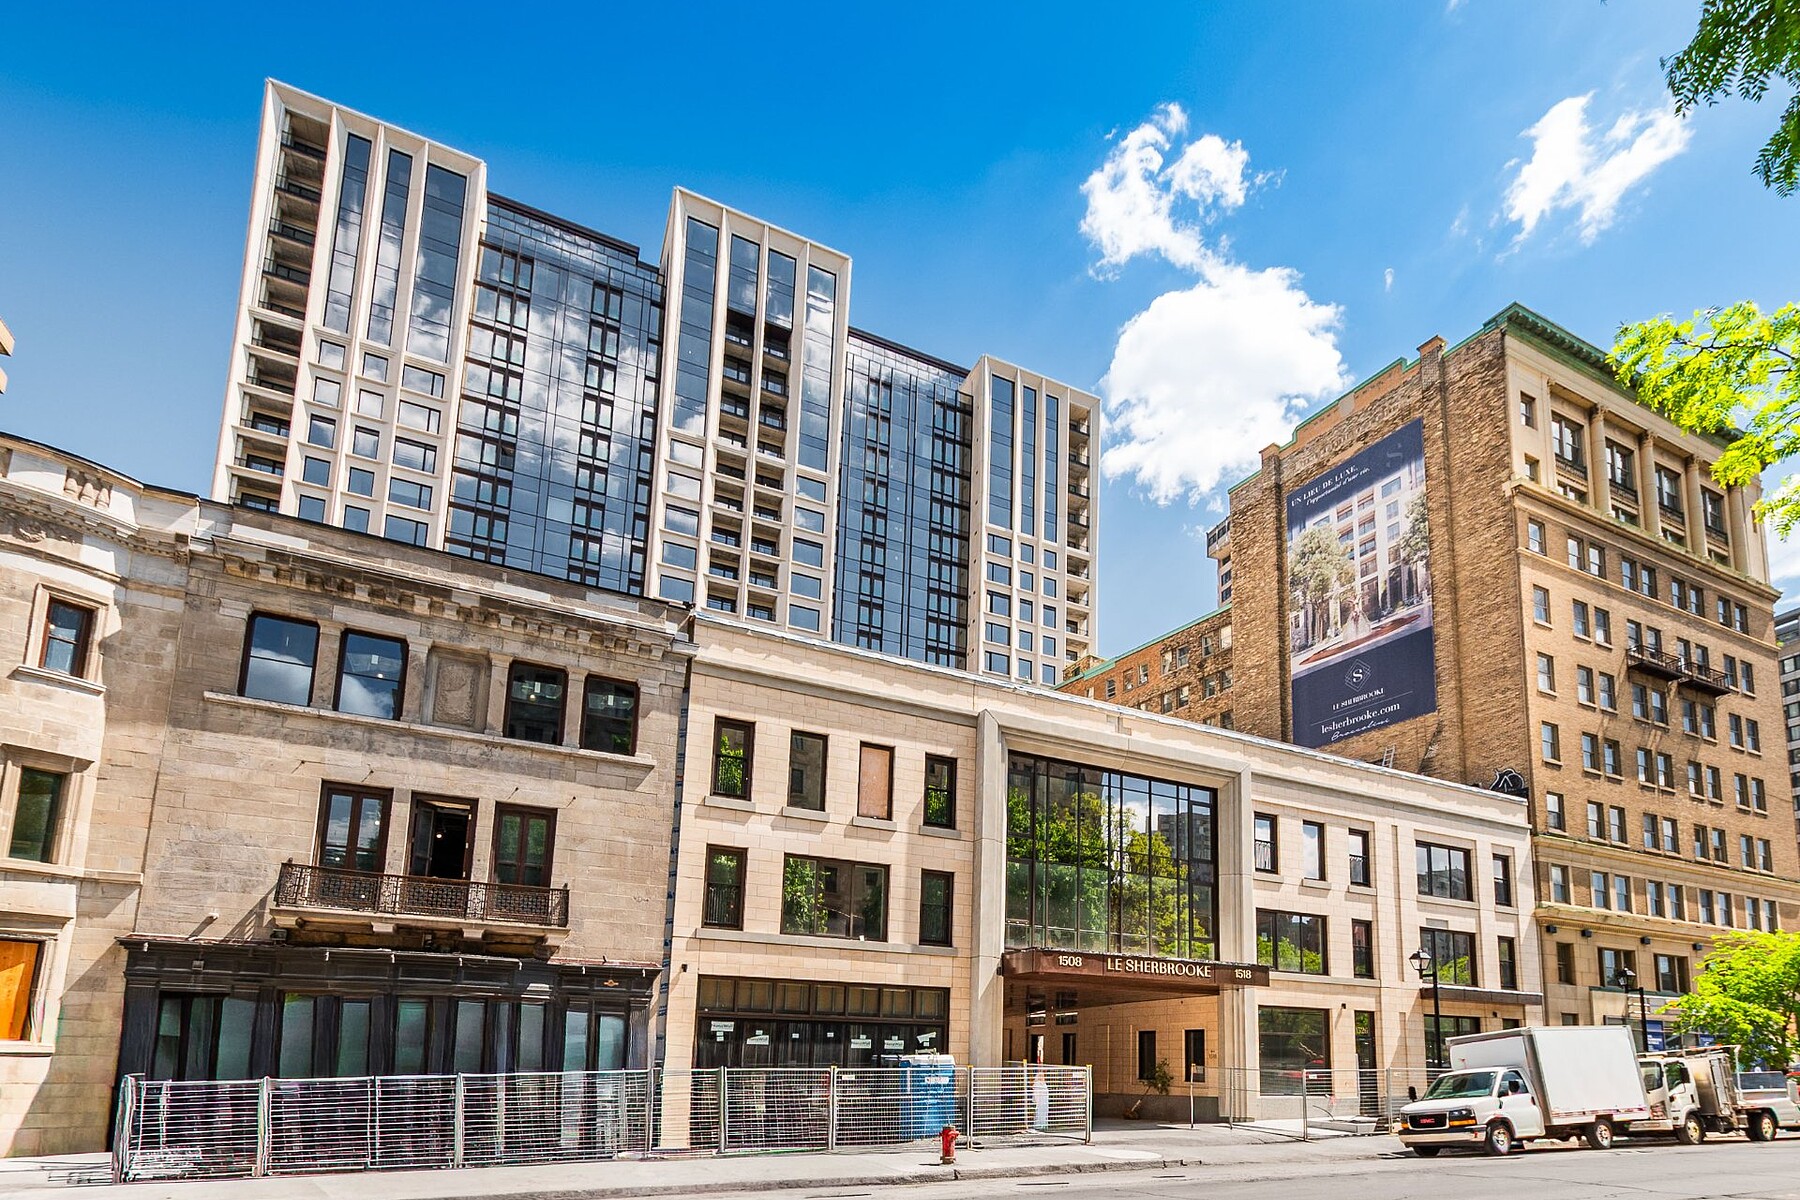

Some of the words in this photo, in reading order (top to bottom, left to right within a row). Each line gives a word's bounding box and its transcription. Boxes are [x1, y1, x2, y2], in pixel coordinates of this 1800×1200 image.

[1291, 495, 1302, 506] UN
[1303, 485, 1320, 500] LIEU
[1322, 478, 1333, 489] DE
[1353, 669, 1363, 683] S
[1341, 688, 1384, 708] SHERBROOKE
[1321, 703, 1400, 733] lesherbrooke.com
[1058, 955, 1082, 967] 1508
[1107, 957, 1122, 971] LE
[1125, 959, 1212, 978] SHERBROOKE
[1234, 969, 1251, 979] 1518
